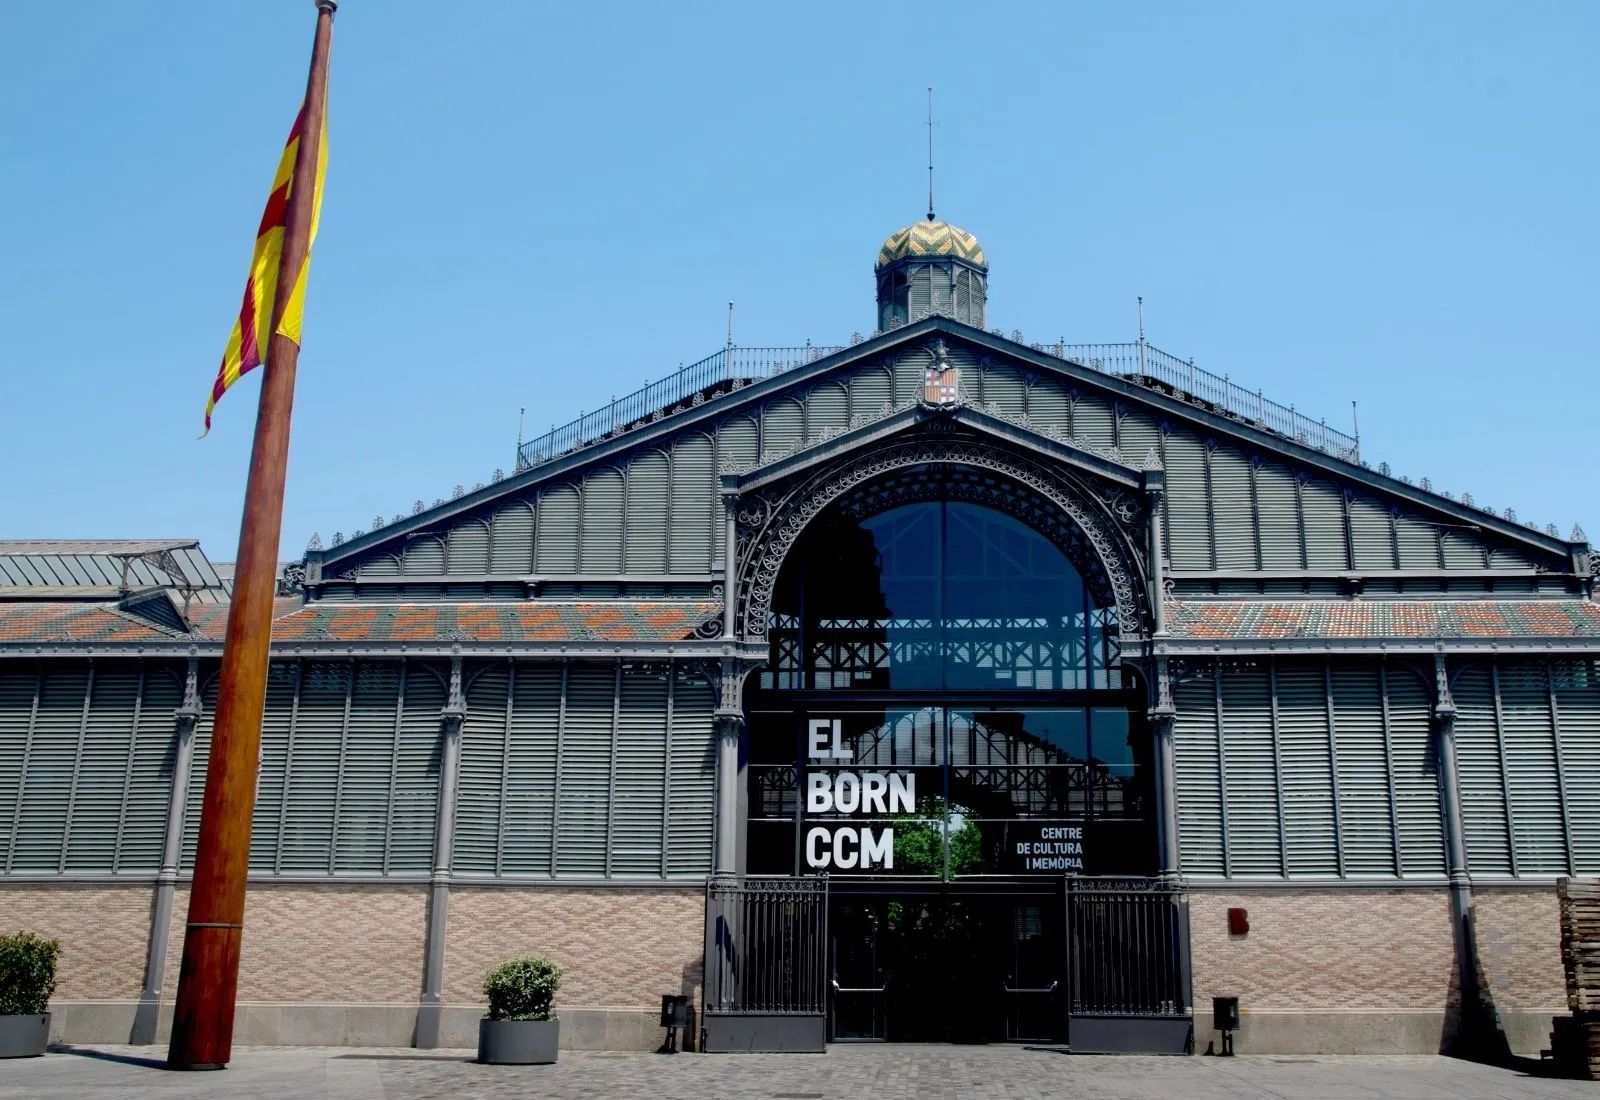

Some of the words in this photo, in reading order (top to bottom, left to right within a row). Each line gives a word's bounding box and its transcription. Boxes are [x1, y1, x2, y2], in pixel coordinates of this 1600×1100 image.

[808, 719, 853, 758] EL
[807, 772, 916, 813] BORN
[1041, 827, 1082, 839] CENTRE
[806, 826, 894, 869] CCM
[1016, 842, 1031, 855] DE
[1033, 842, 1083, 855] CULTURA
[1026, 857, 1030, 869] I
